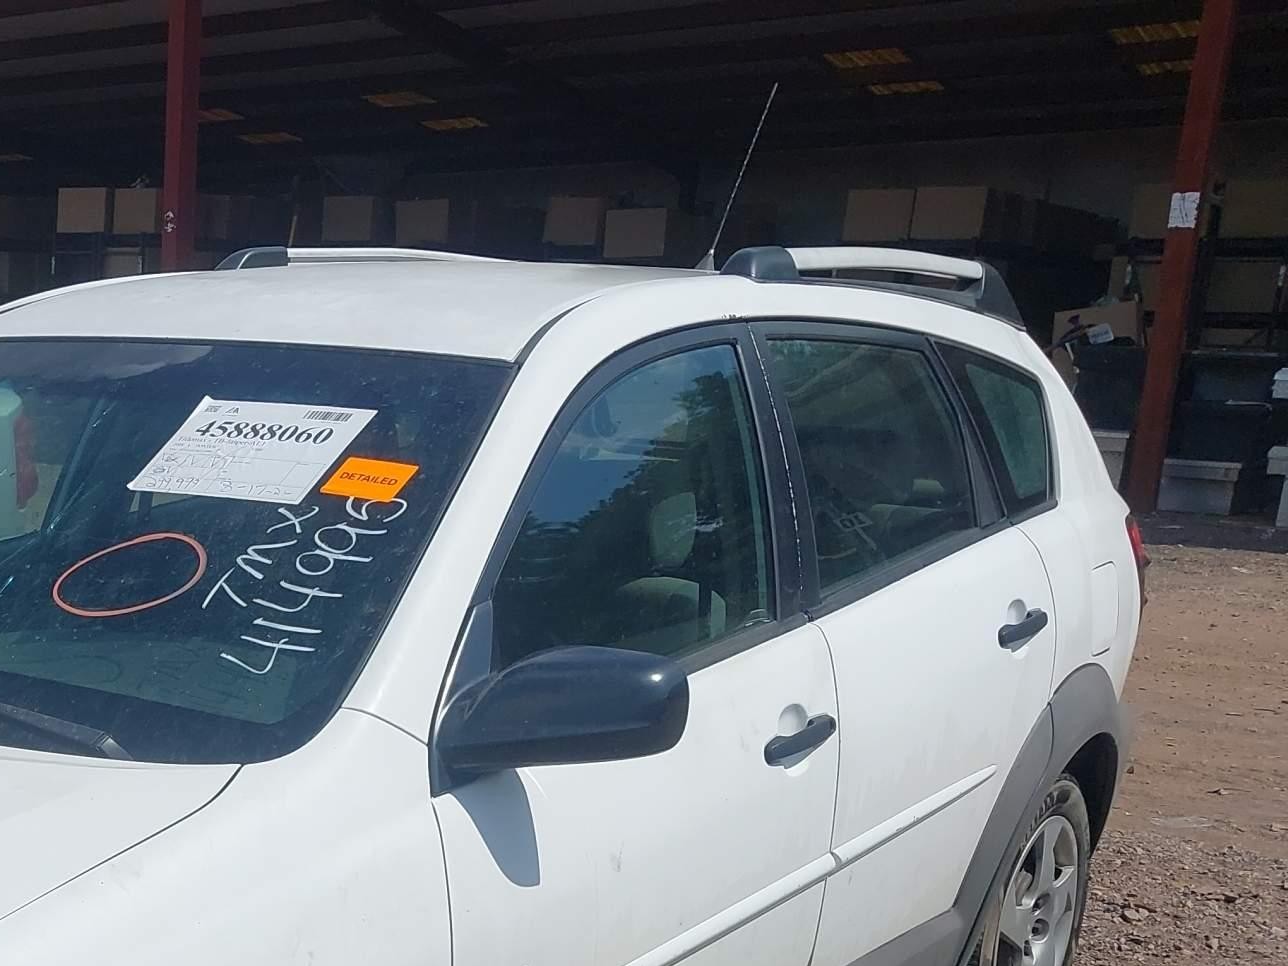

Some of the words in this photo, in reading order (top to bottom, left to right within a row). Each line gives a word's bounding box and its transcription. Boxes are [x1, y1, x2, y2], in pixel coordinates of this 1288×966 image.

[195, 420, 334, 445] 45888060
[339, 471, 398, 487] DETAILED
[201, 505, 319, 610] TMX
